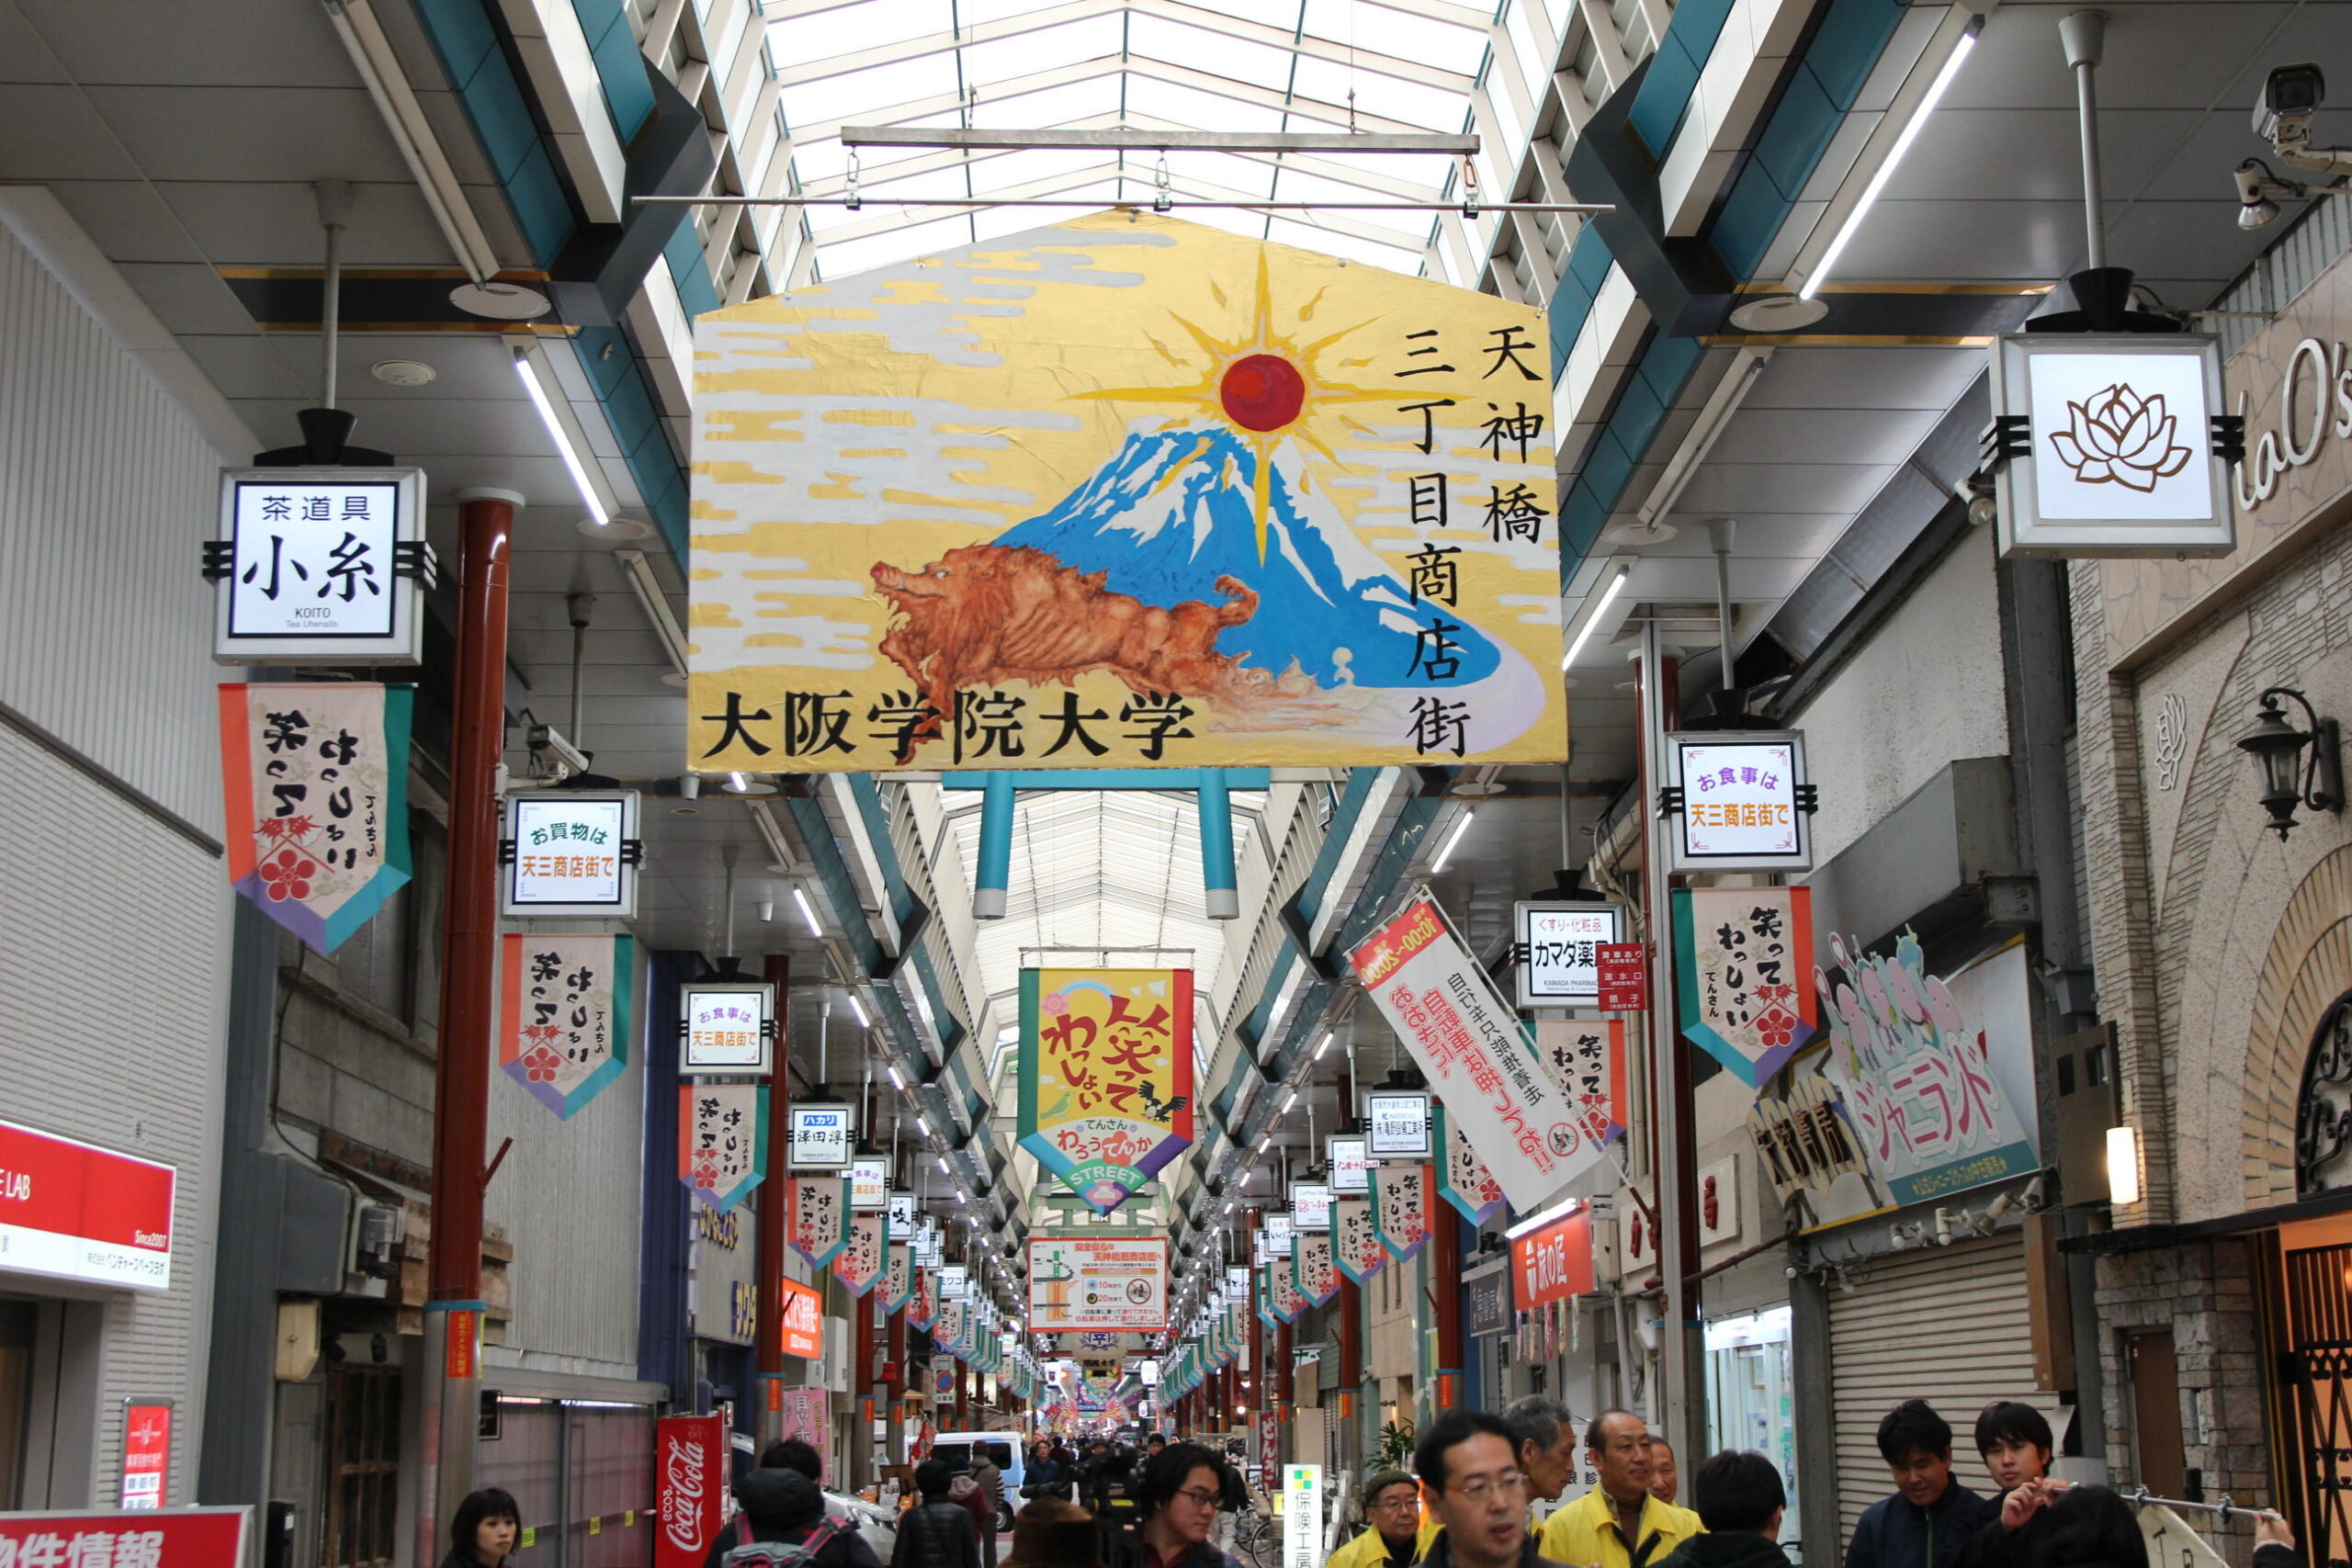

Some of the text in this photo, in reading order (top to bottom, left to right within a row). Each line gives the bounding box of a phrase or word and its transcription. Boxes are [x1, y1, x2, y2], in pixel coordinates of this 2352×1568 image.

[1479, 325, 1551, 544] 天神橋
[262, 495, 371, 522] 茶道具
[1394, 330, 1472, 759] 三丁目商店街
[243, 531, 380, 603] 小糸
[285, 620, 338, 628] Tea Utensils
[295, 607, 332, 618] KOITO
[700, 688, 1195, 766] 大阪学院大学
[1698, 766, 1780, 792] お食事は
[1690, 802, 1789, 828] 天三商店街で
[530, 821, 608, 845] お買物は
[522, 855, 616, 878] 天三商店街で
[1535, 941, 1609, 968] カマダ薬
[1749, 907, 1784, 985] 笑って
[1716, 922, 1750, 1027] わっしょい
[1705, 971, 1719, 1018] てんさん
[698, 1007, 752, 1022] お食事は
[692, 1031, 757, 1047] 天三商店街で
[1040, 1013, 1102, 1111] わっしょい
[1102, 994, 1171, 1114] 笑って
[1577, 1034, 1602, 1094] 笑って
[805, 1116, 836, 1125] ハカリ
[1086, 1119, 1128, 1131] てんさん
[1057, 1129, 1152, 1160] わろうてんか
[6, 1170, 32, 1201] LAB
[853, 1184, 882, 1194] 商店街で
[1070, 1166, 1140, 1187] STREET
[1386, 1183, 1401, 1234] わっしょい
[1403, 1175, 1419, 1213] 笑って
[134, 1228, 167, 1248] Since2007
[666, 1434, 705, 1551] Coca-Cola
